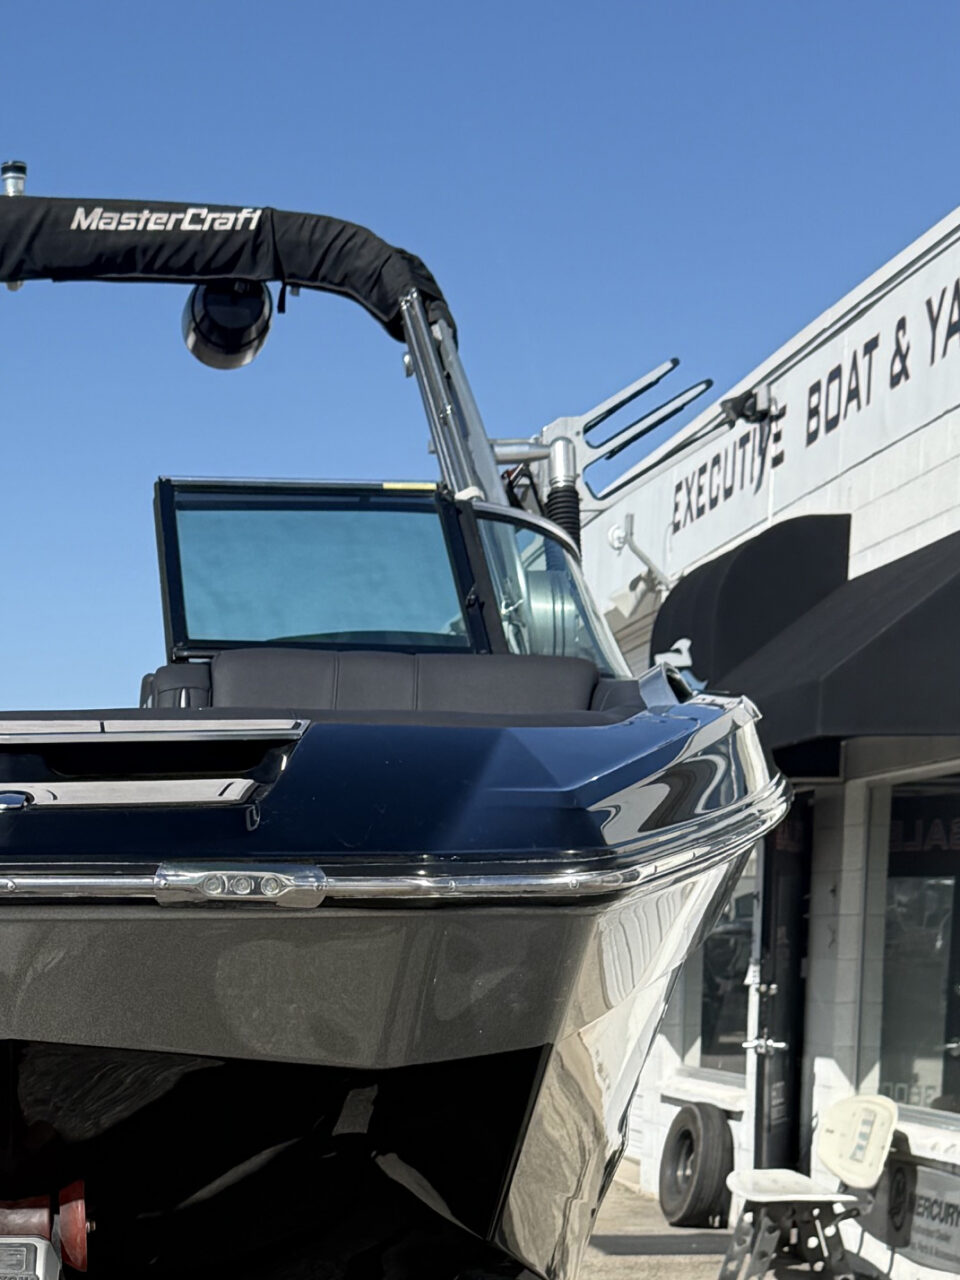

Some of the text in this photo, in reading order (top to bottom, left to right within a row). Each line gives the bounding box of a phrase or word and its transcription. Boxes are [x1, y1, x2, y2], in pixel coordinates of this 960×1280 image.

[70, 206, 263, 231] MasterCraft
[672, 404, 787, 535] EXECUTIVE
[806, 332, 880, 447] BOAT
[889, 315, 910, 390] &
